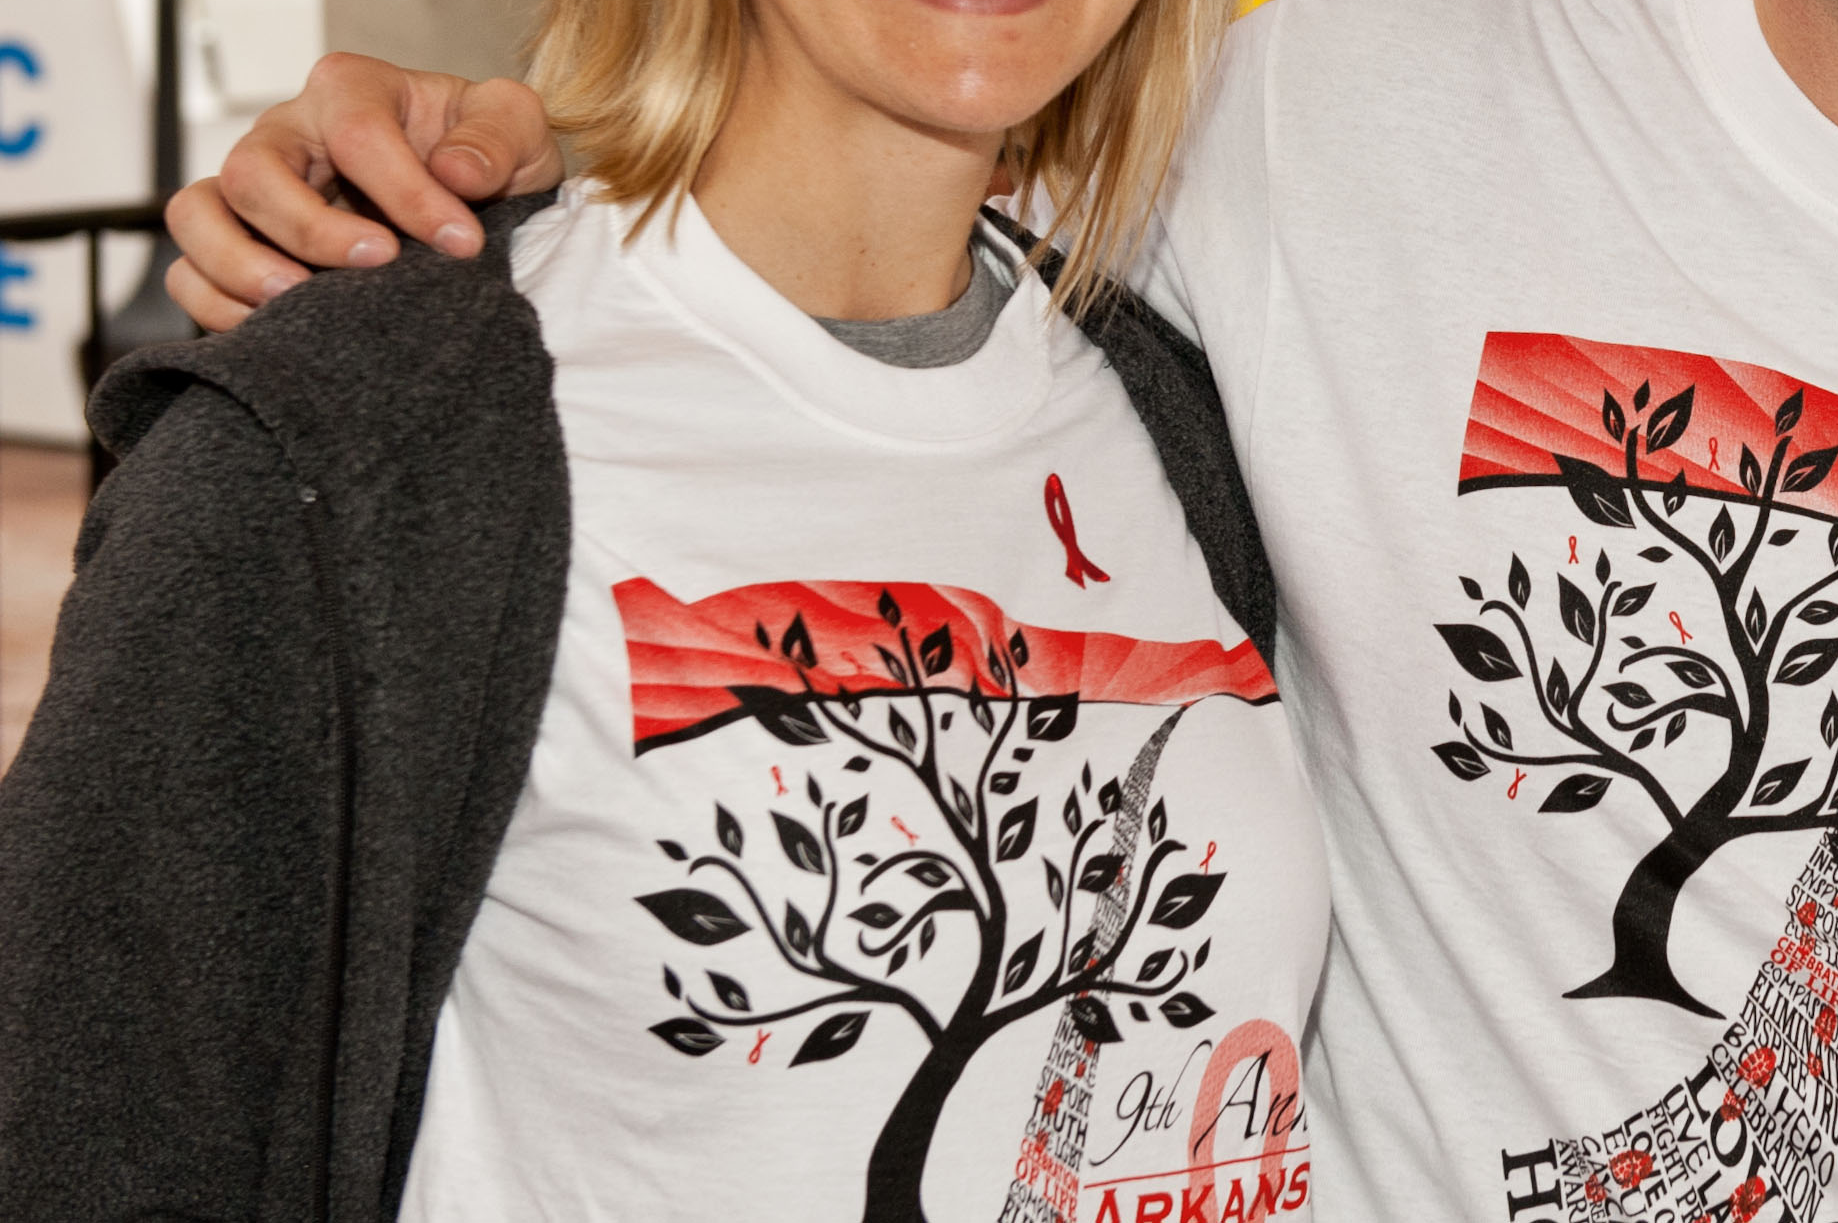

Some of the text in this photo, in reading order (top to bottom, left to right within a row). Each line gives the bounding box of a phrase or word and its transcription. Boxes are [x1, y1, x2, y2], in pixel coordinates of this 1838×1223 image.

[1770, 949, 1803, 975] OF
[1739, 995, 1807, 1103] INSPIRE
[1089, 1039, 1213, 1167] 9th
[1646, 1099, 1690, 1187] FIGHT
[1662, 1083, 1711, 1174] LIVE
[1773, 1086, 1835, 1188] HERO
